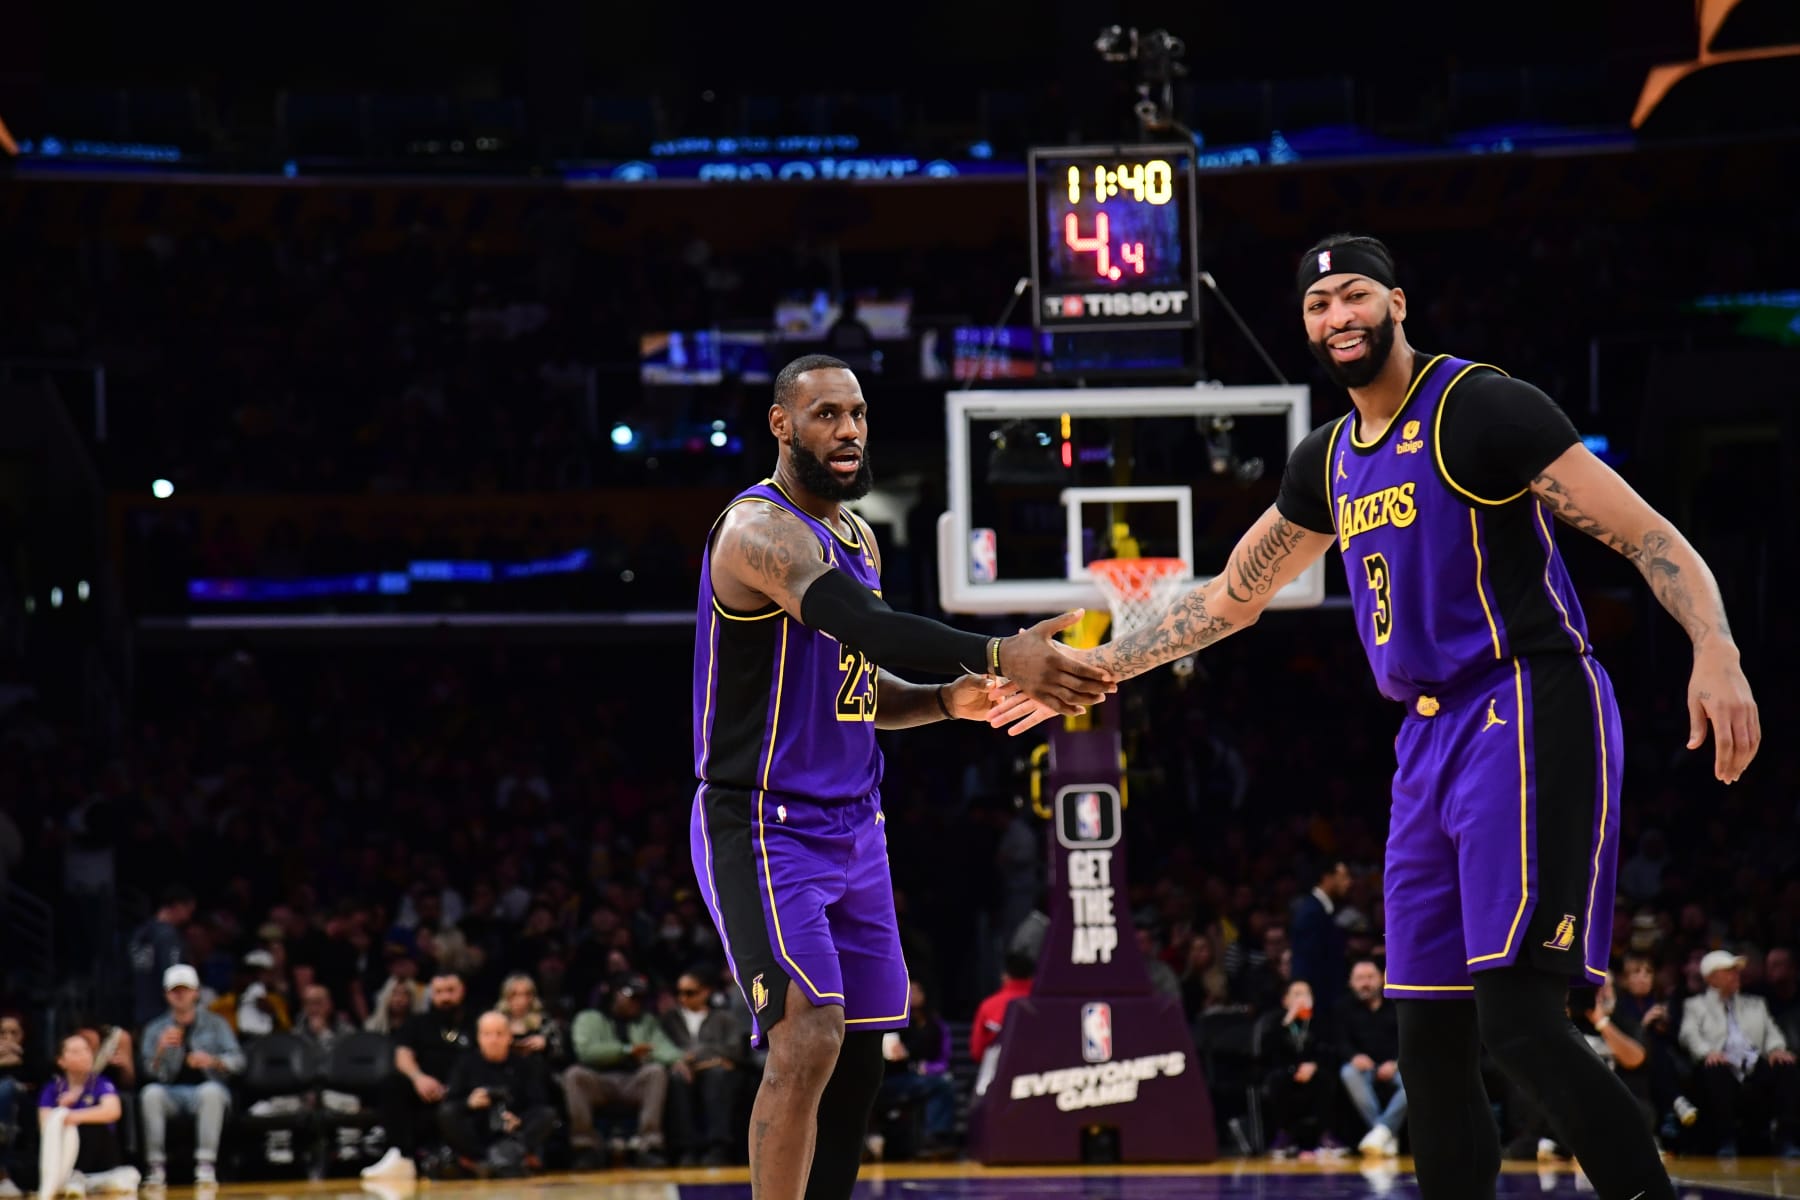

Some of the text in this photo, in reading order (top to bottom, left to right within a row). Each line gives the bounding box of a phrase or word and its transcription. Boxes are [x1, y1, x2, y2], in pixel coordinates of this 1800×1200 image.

[1068, 160, 1172, 205] 11:40
[1396, 440, 1424, 455] bibigo
[1337, 482, 1417, 553] LAKERS
[1227, 516, 1293, 602] Chicago
[1363, 552, 1392, 646] 3
[836, 642, 879, 722] 23
[1068, 850, 1113, 888] GET
[1069, 887, 1117, 926] THE
[1071, 925, 1118, 965] APP
[1010, 1051, 1186, 1100] EVERYONE'S
[1056, 1079, 1139, 1112] GAME
